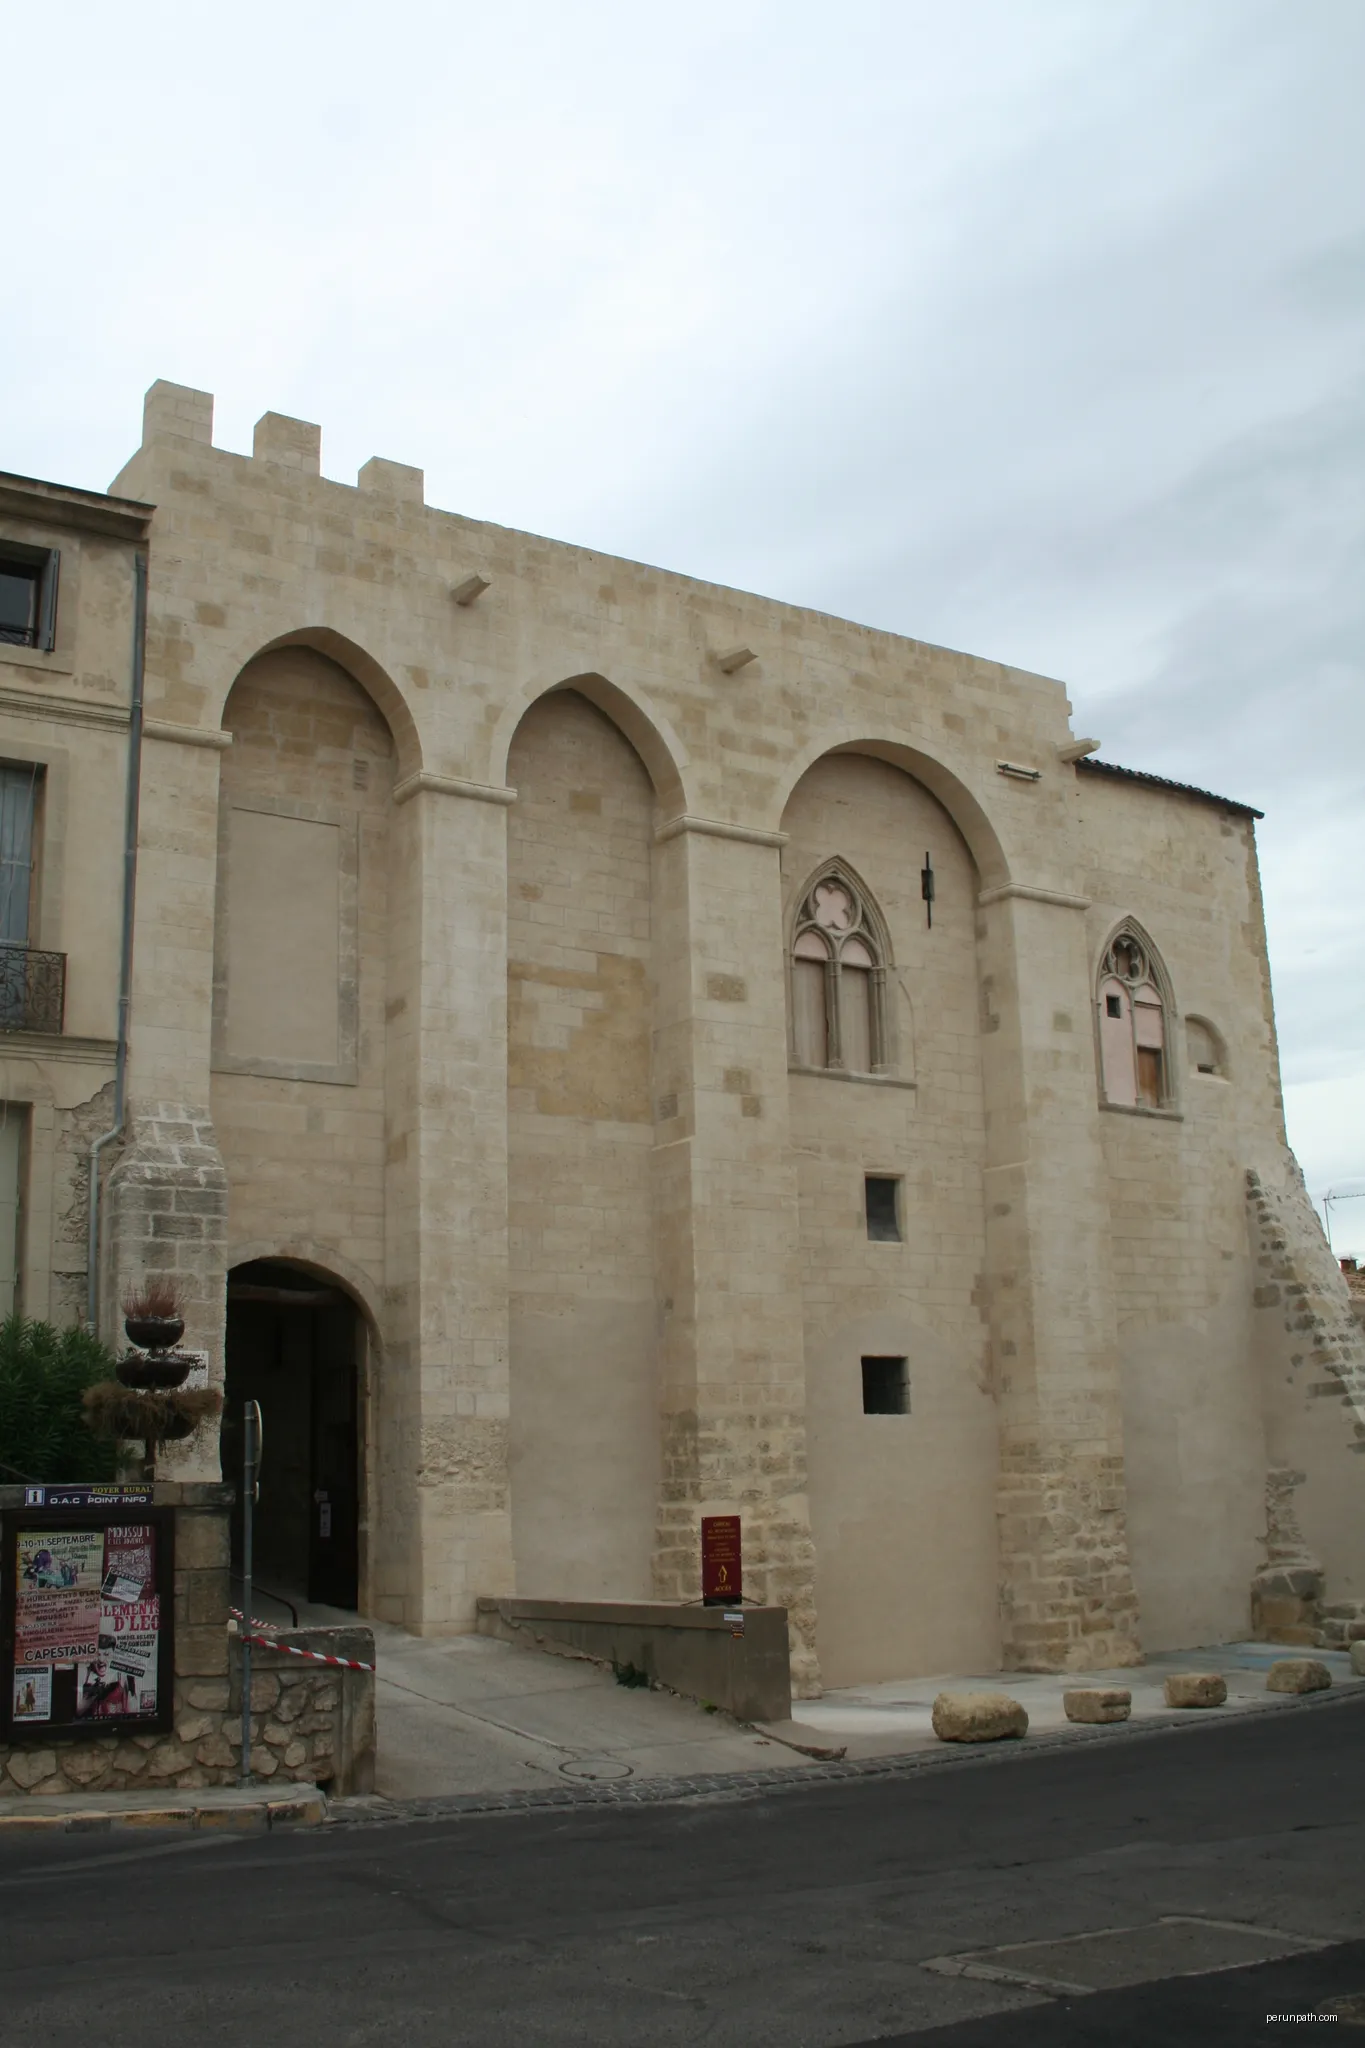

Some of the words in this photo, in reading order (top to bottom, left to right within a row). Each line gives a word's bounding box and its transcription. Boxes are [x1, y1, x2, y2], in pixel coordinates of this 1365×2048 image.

[92, 1486, 120, 1494] FOYER
[123, 1486, 152, 1494] RURAL
[50, 1497, 80, 1505] O.A.C
[88, 1496, 119, 1504] POINT
[47, 1534, 95, 1546] SEPTEMBRE
[25, 1643, 97, 1661] CAPESTANG
